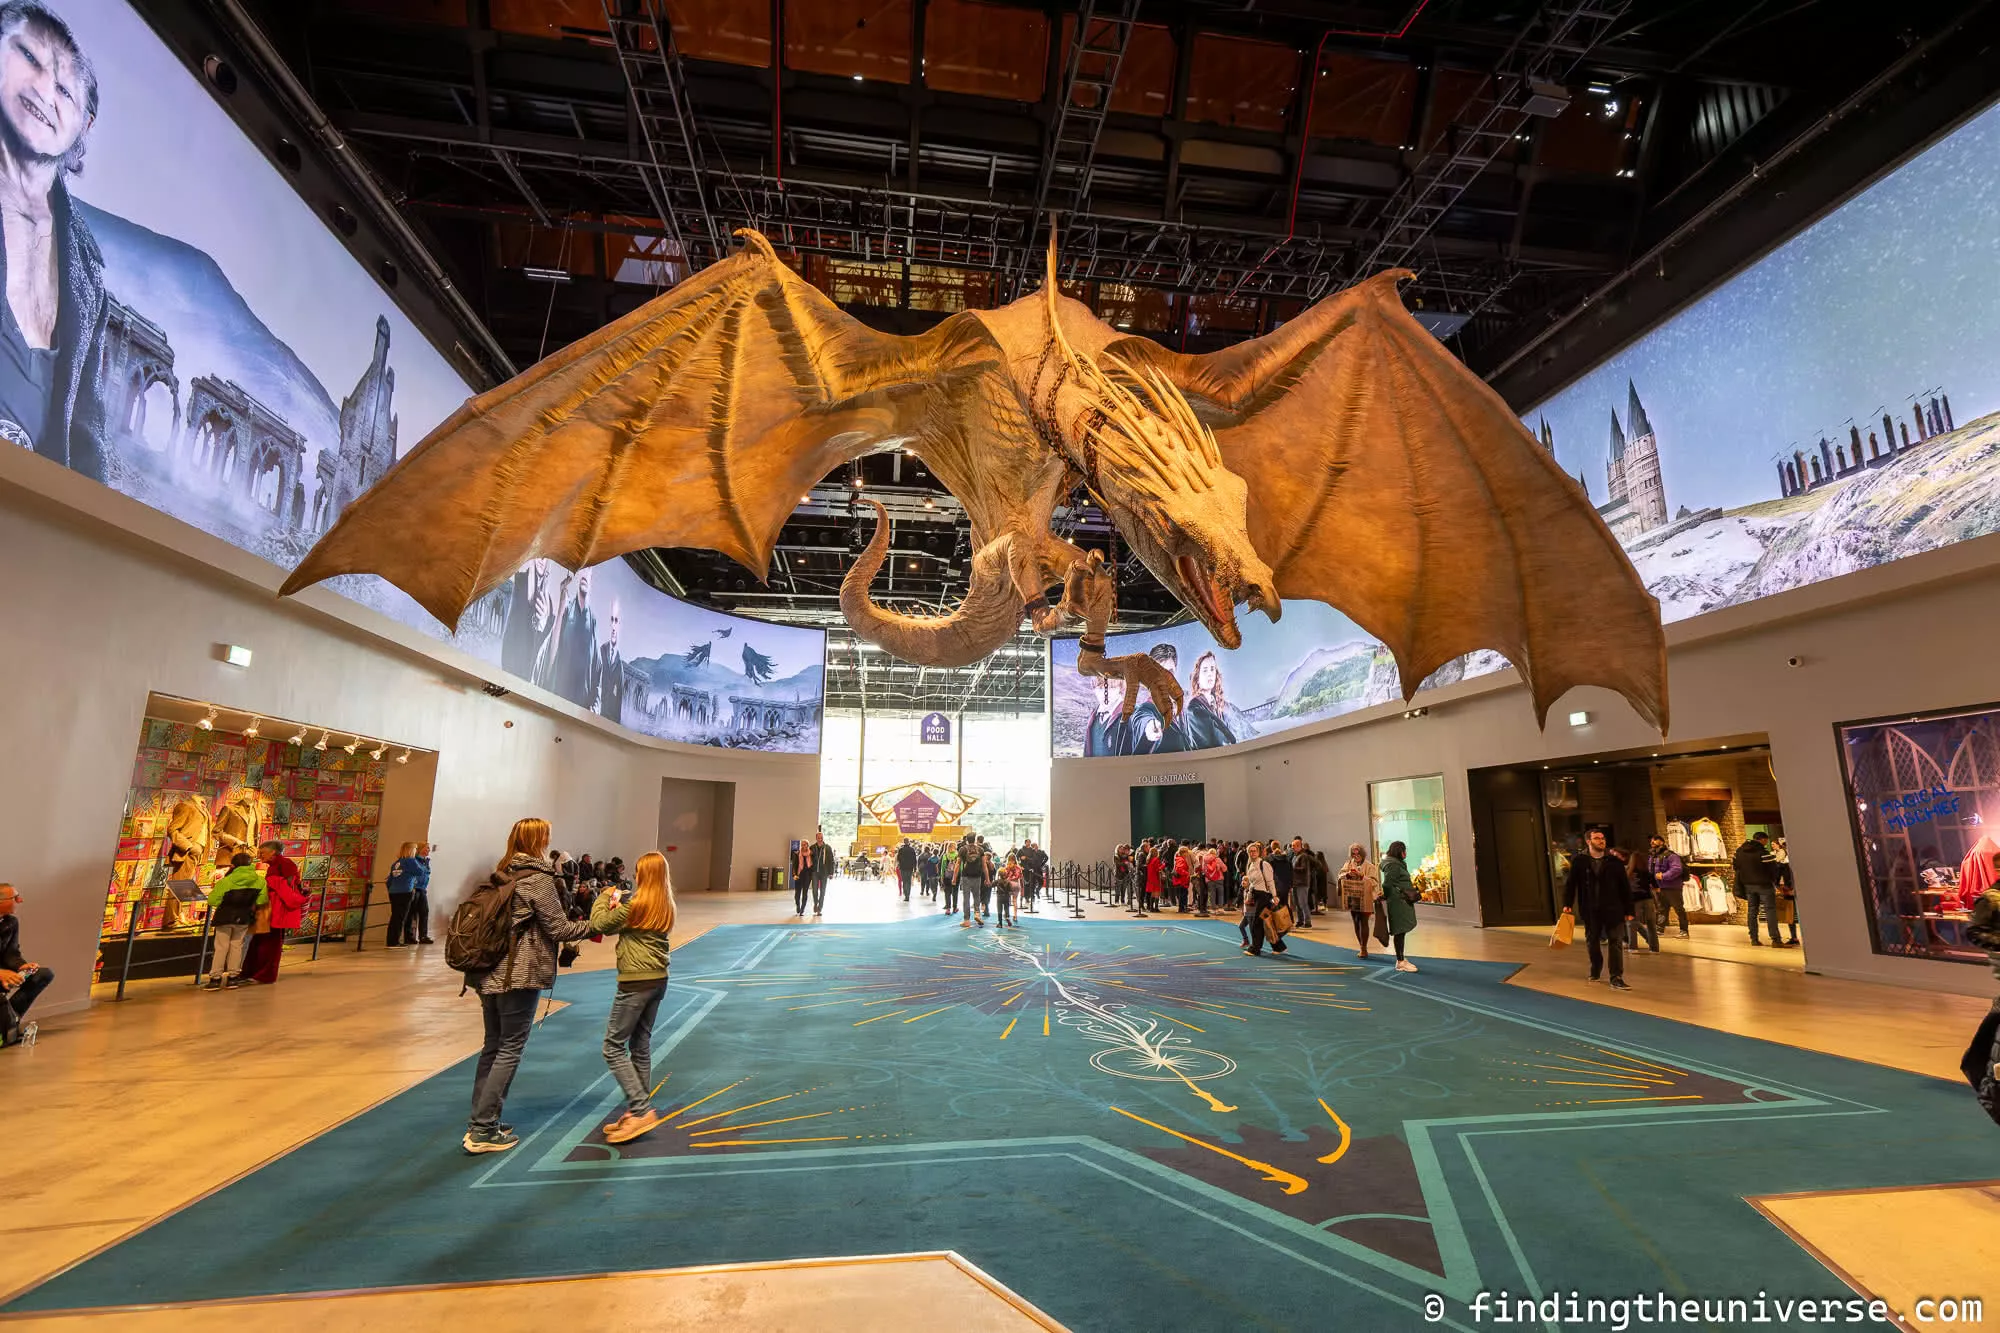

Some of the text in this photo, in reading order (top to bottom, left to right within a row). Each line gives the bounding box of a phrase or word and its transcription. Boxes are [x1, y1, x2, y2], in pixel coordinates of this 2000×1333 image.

[926, 726, 945, 734] FOOD
[926, 734, 945, 742] HALL
[1138, 772, 1196, 783] TOUR ENTRANCE
[1880, 783, 1953, 816] MAGICAL
[1887, 797, 1960, 830] MISCHIEF
